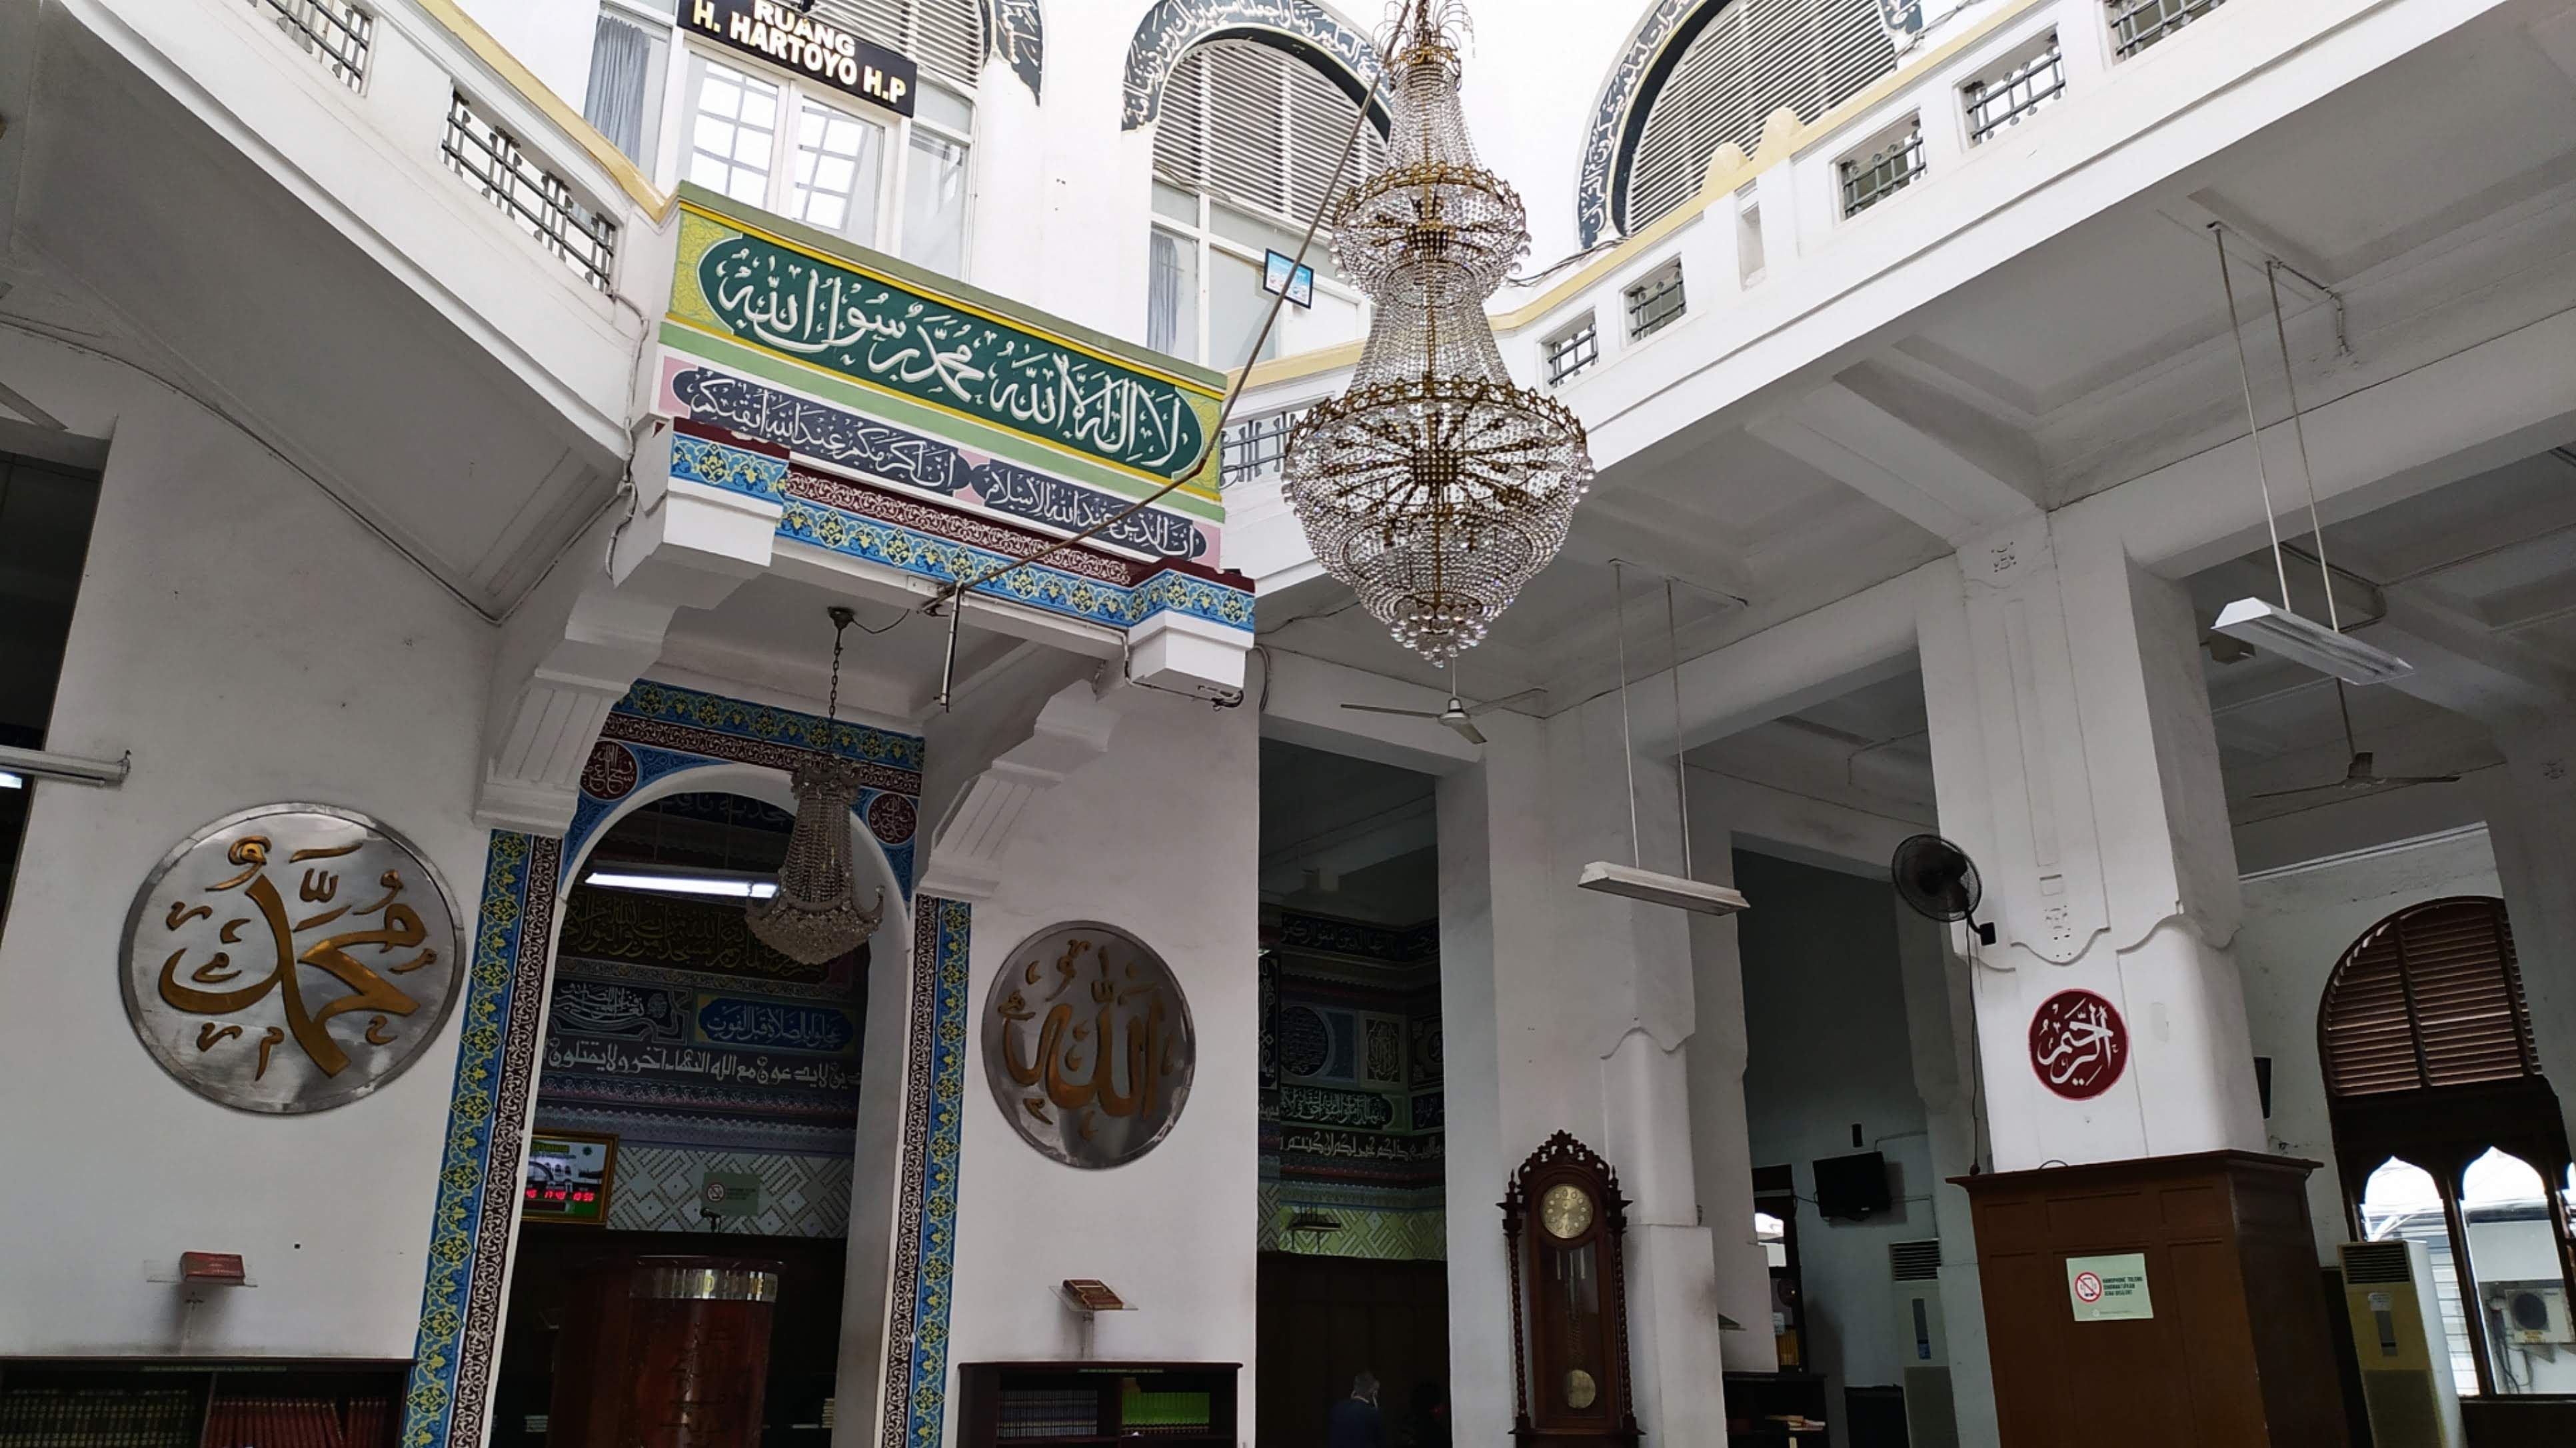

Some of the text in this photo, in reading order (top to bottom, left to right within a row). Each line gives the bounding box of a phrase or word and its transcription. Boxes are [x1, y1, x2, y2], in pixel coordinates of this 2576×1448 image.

[693, 0, 906, 103] H. HARTOYO H.P
[753, 0, 856, 57] RUANG
